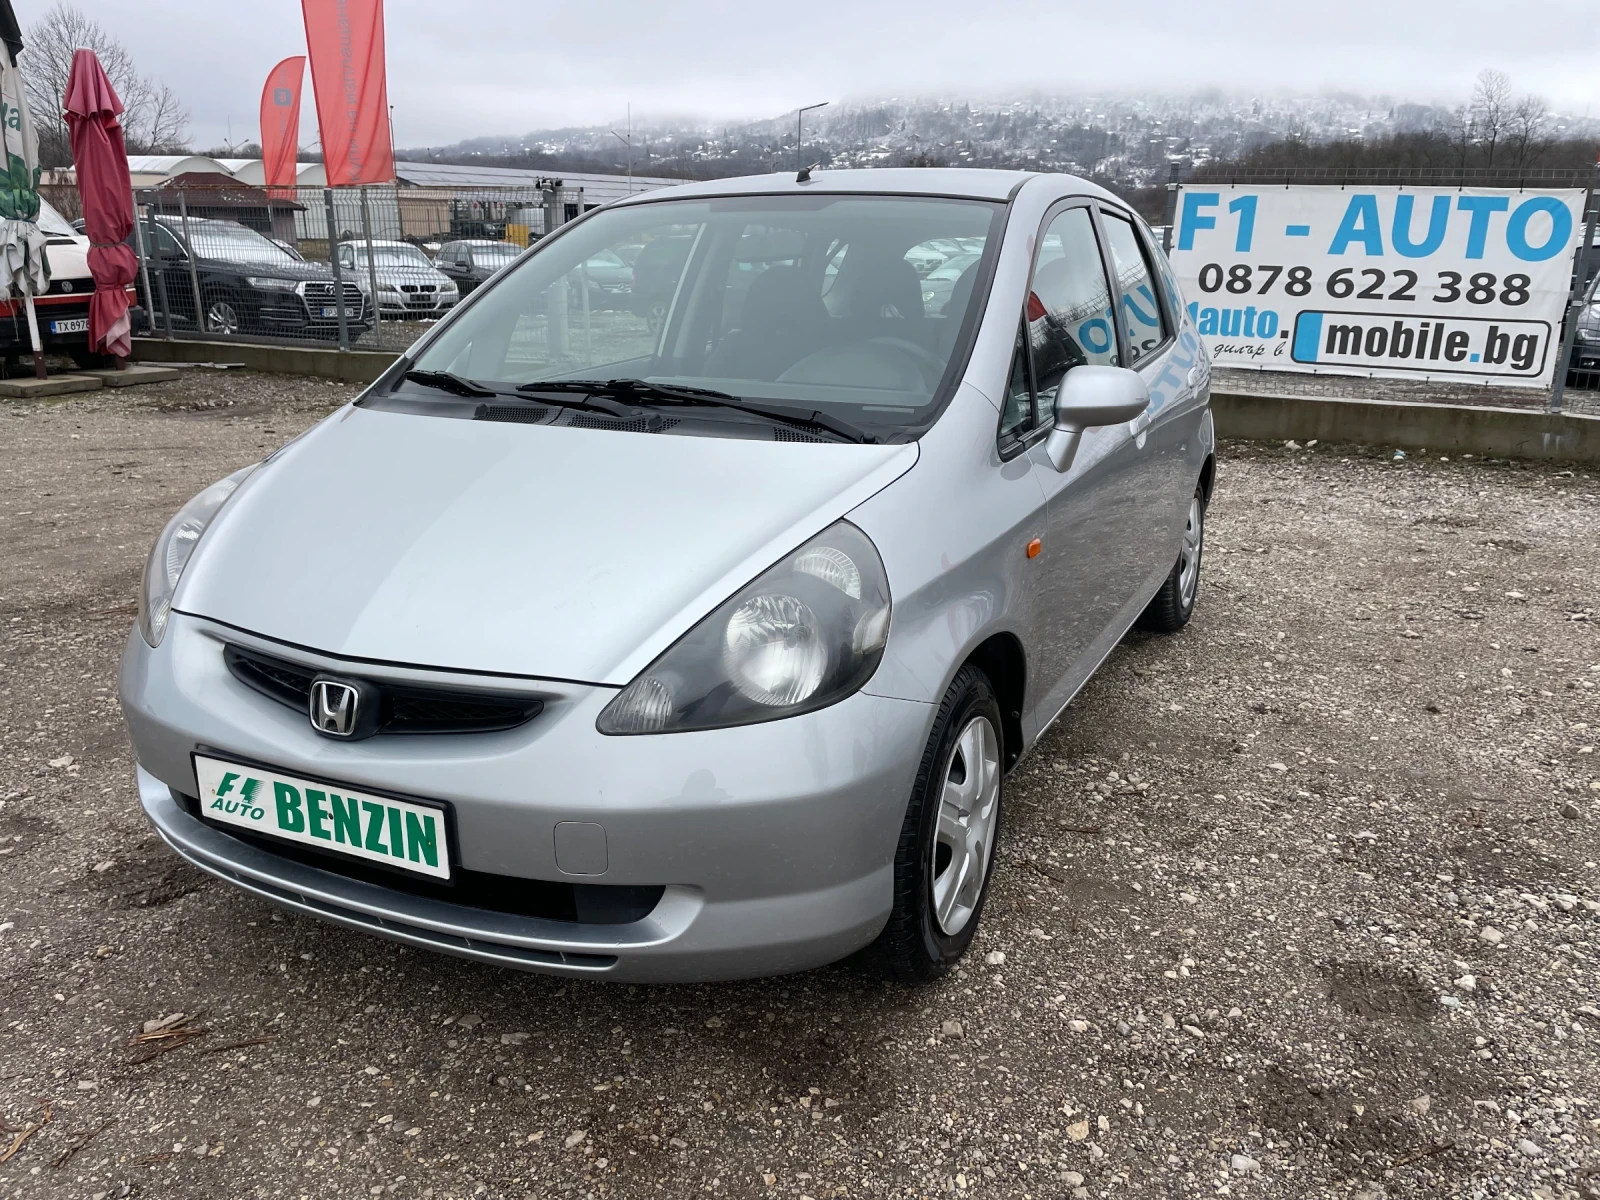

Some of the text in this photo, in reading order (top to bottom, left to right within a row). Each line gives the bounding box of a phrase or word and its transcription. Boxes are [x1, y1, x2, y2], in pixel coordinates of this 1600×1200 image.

[1178, 193, 1258, 252] F1
[1327, 194, 1573, 262] AUTO
[1198, 263, 1531, 305] 0878 622 388
[1213, 343, 1266, 359] дилър
[1325, 321, 1539, 370] mobile.bg
[210, 797, 265, 821] AUTO
[273, 781, 439, 868] BENZIN
